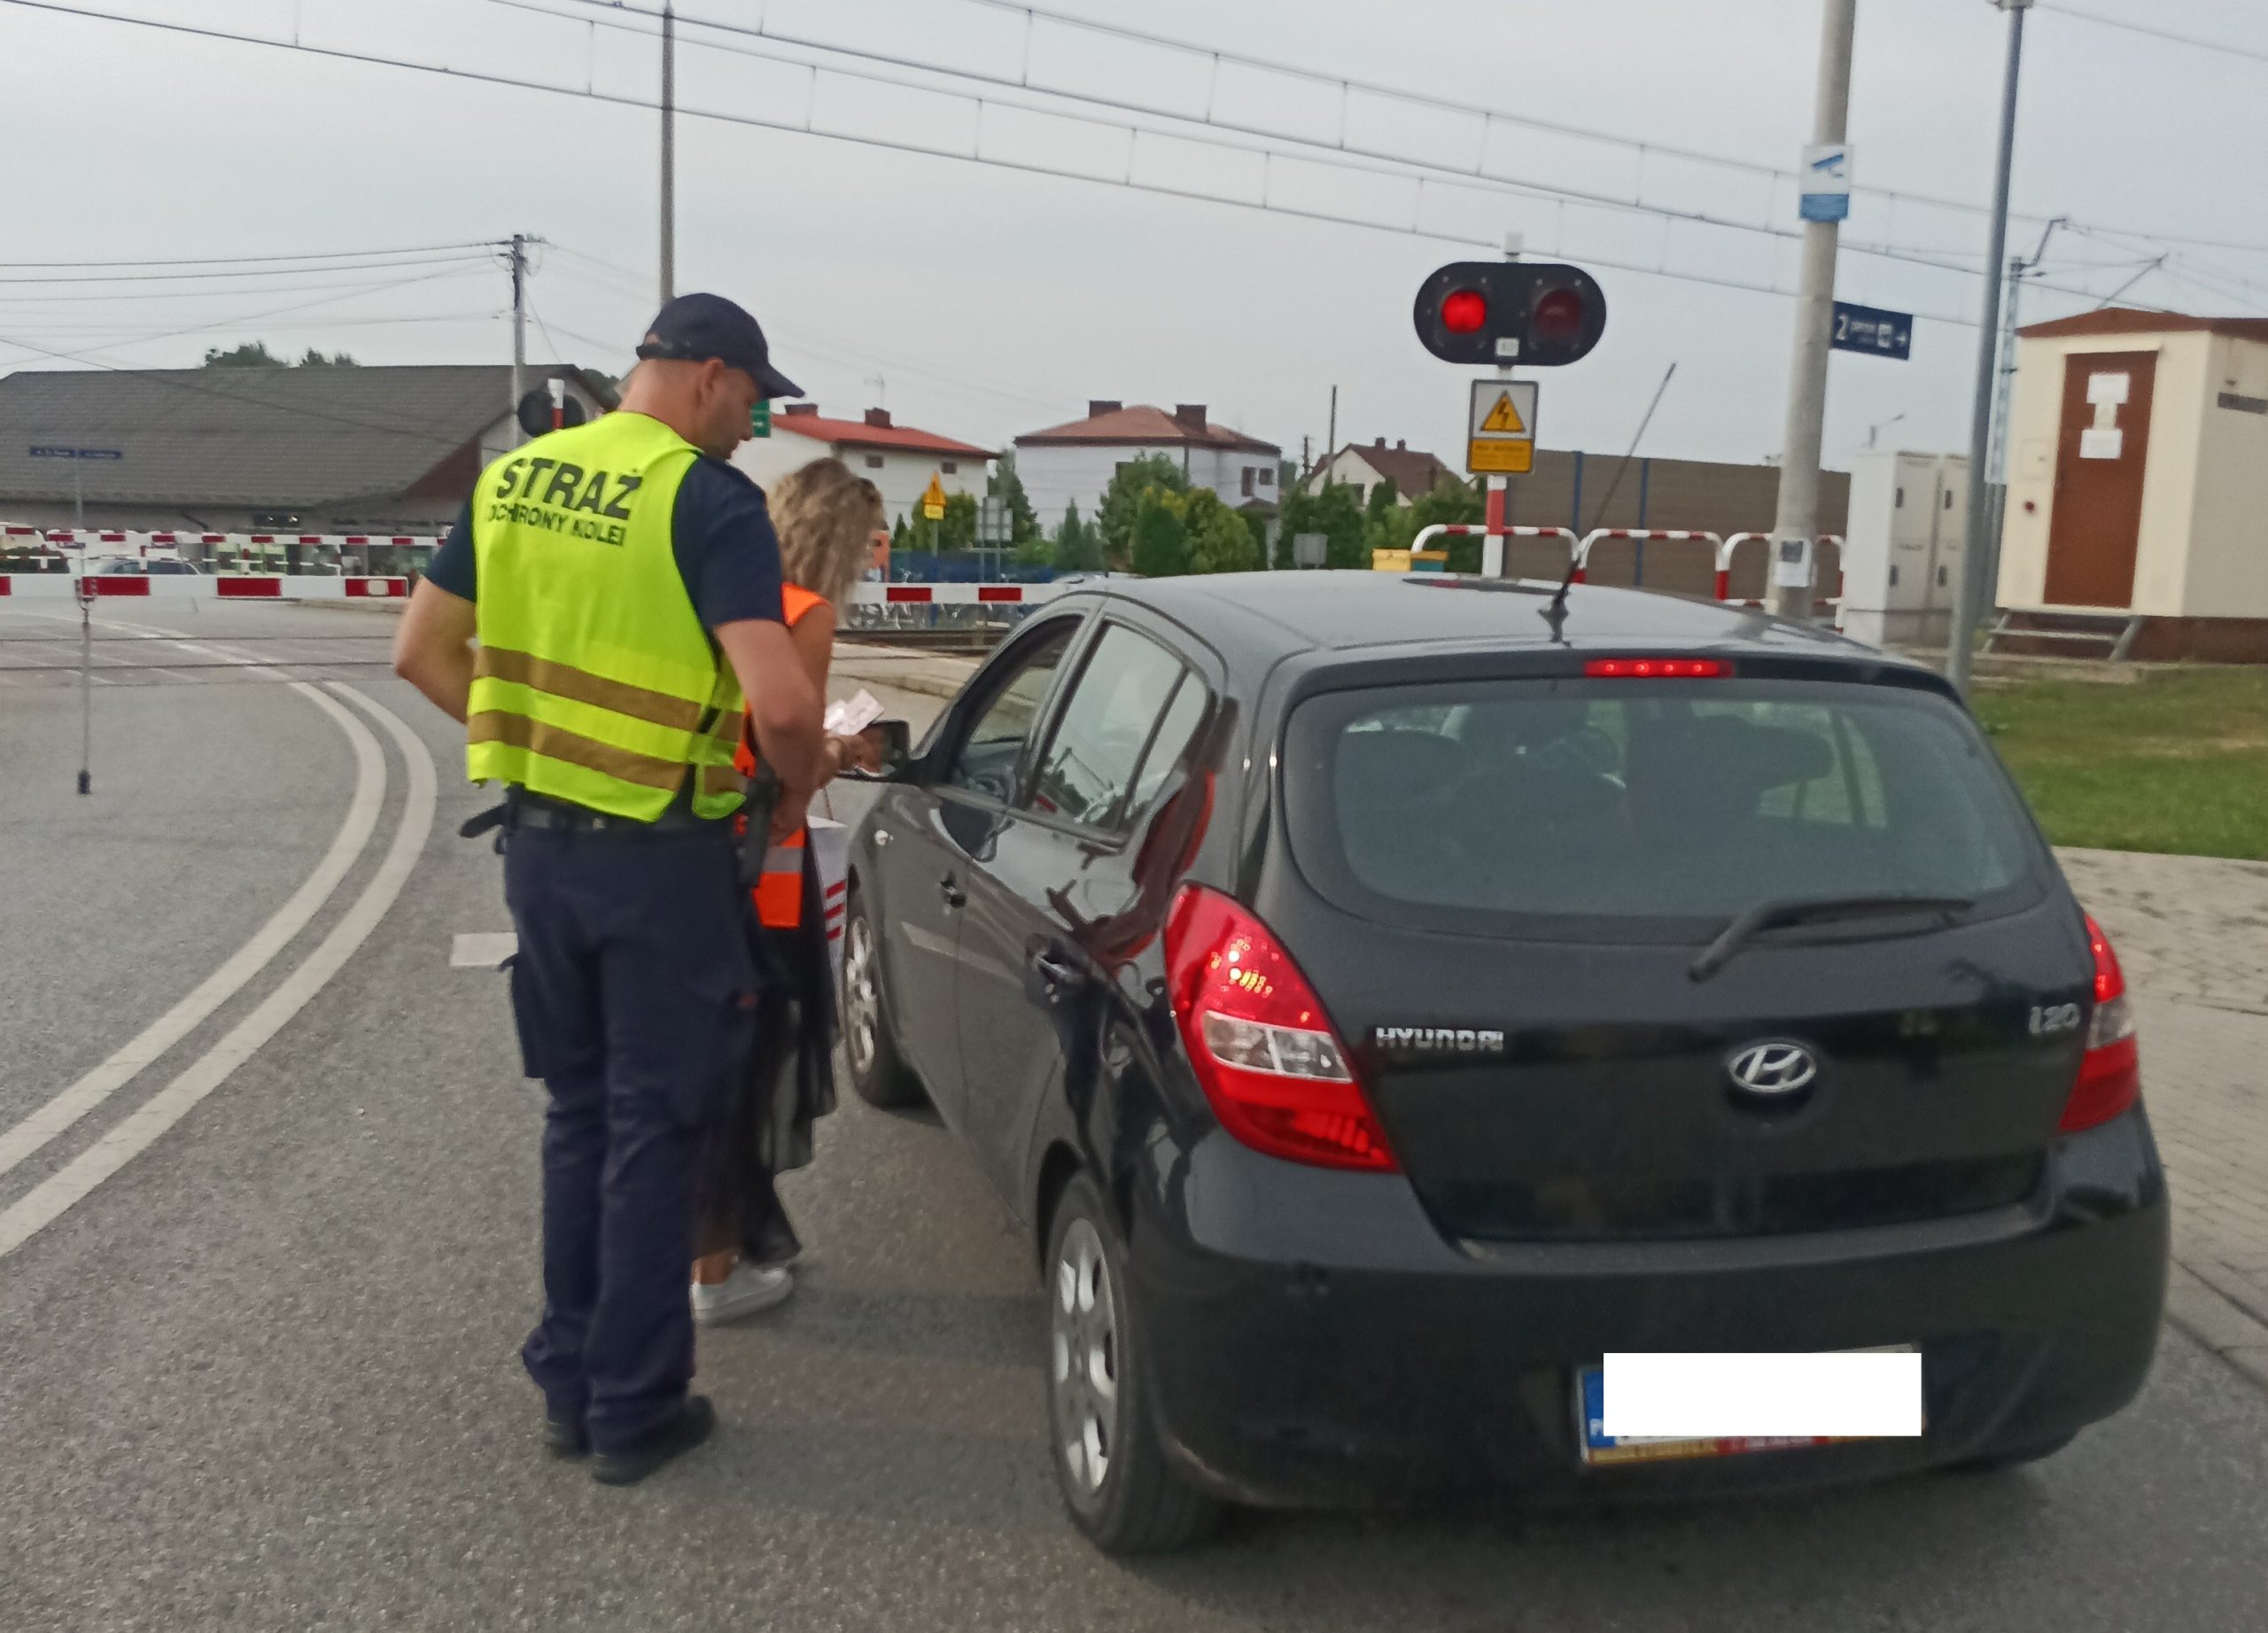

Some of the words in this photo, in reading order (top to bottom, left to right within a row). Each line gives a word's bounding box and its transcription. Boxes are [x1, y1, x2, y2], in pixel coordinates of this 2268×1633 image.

[1835, 313, 1850, 340] 2
[496, 456, 643, 521] STRAŻ
[1375, 1027, 1505, 1052] HYUNDAI
